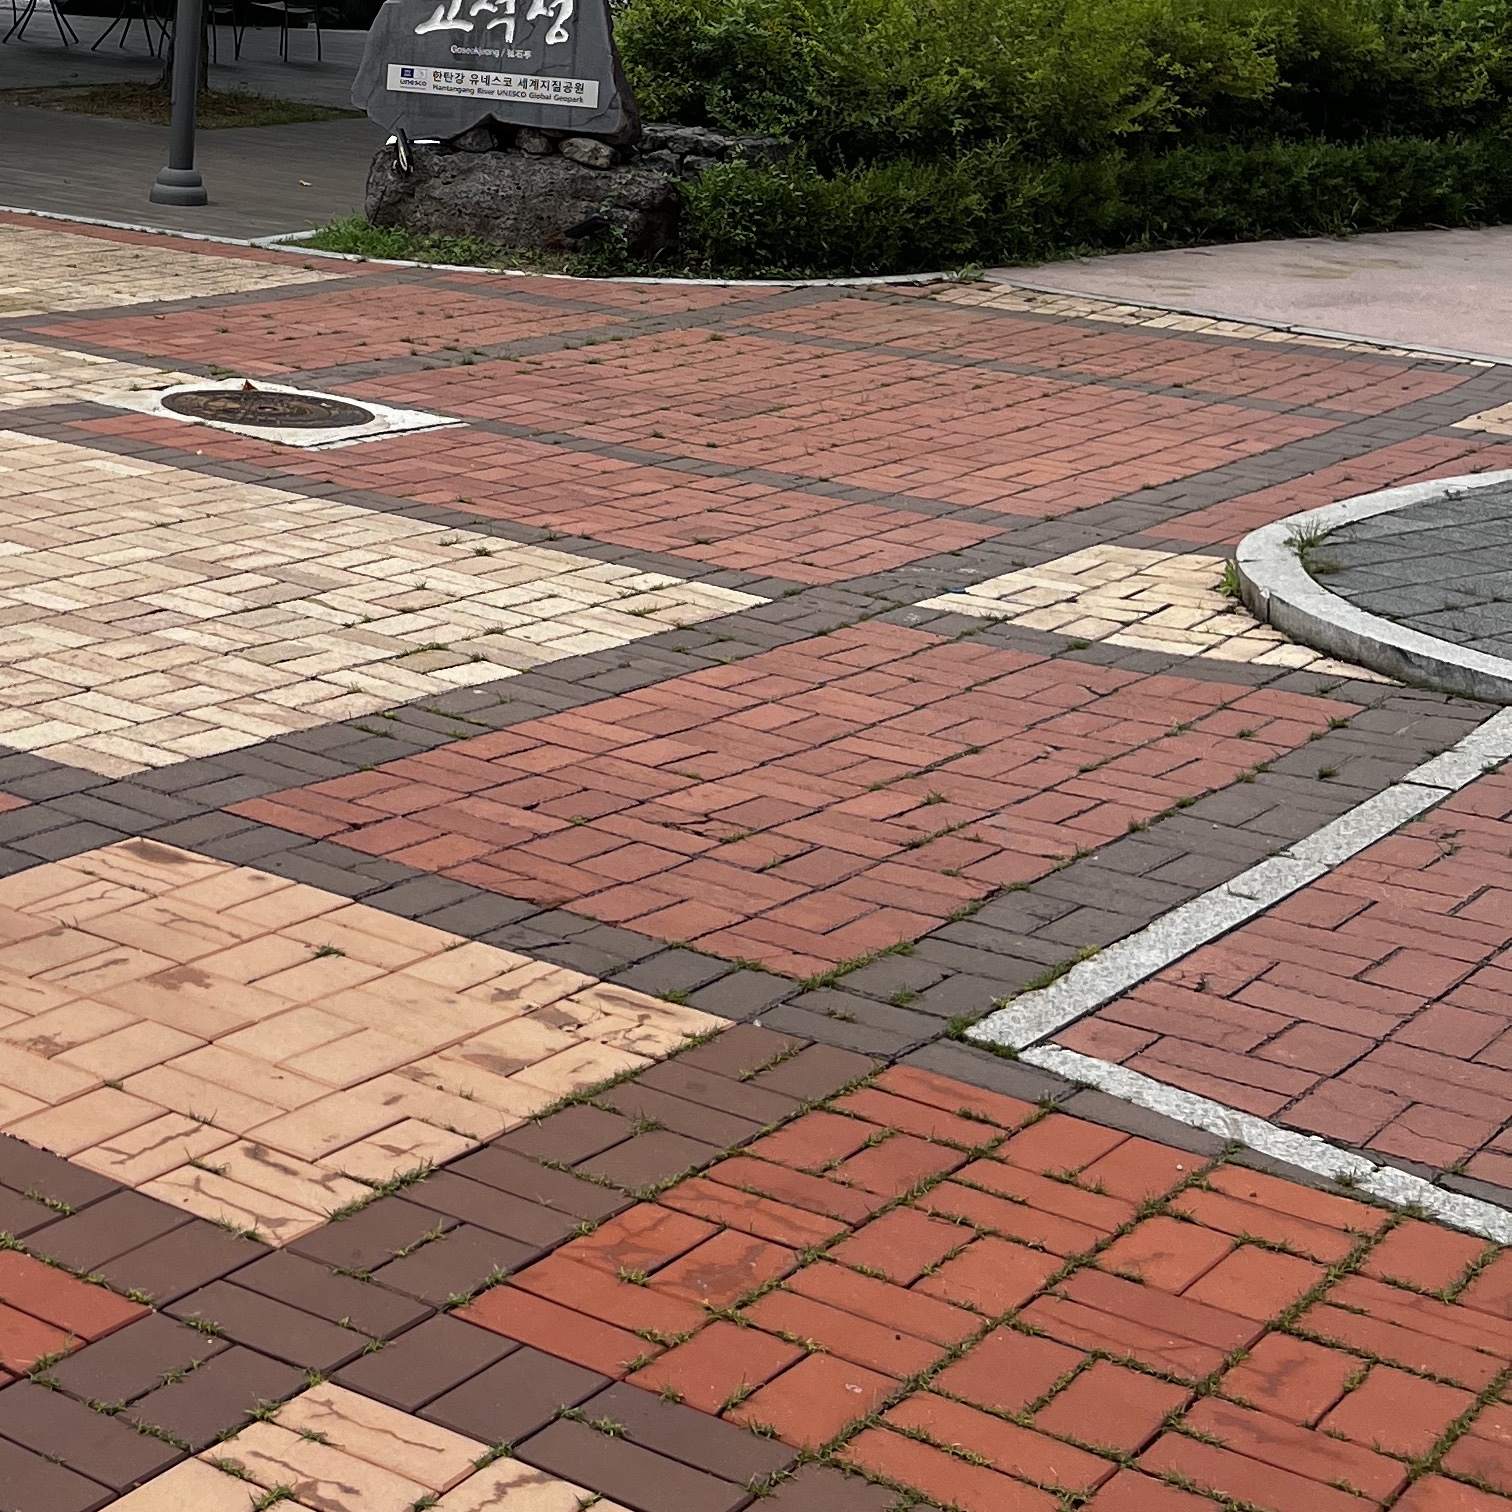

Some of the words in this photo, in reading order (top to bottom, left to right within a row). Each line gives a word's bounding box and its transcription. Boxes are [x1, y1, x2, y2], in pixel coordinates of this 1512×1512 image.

[432, 70, 466, 85] 한탄강
[469, 73, 512, 87] 유네스코
[517, 77, 585, 95] 세계지질공원
[497, 89, 527, 98] UNESCO
[529, 92, 552, 101] Global
[553, 94, 584, 104] Geopark
